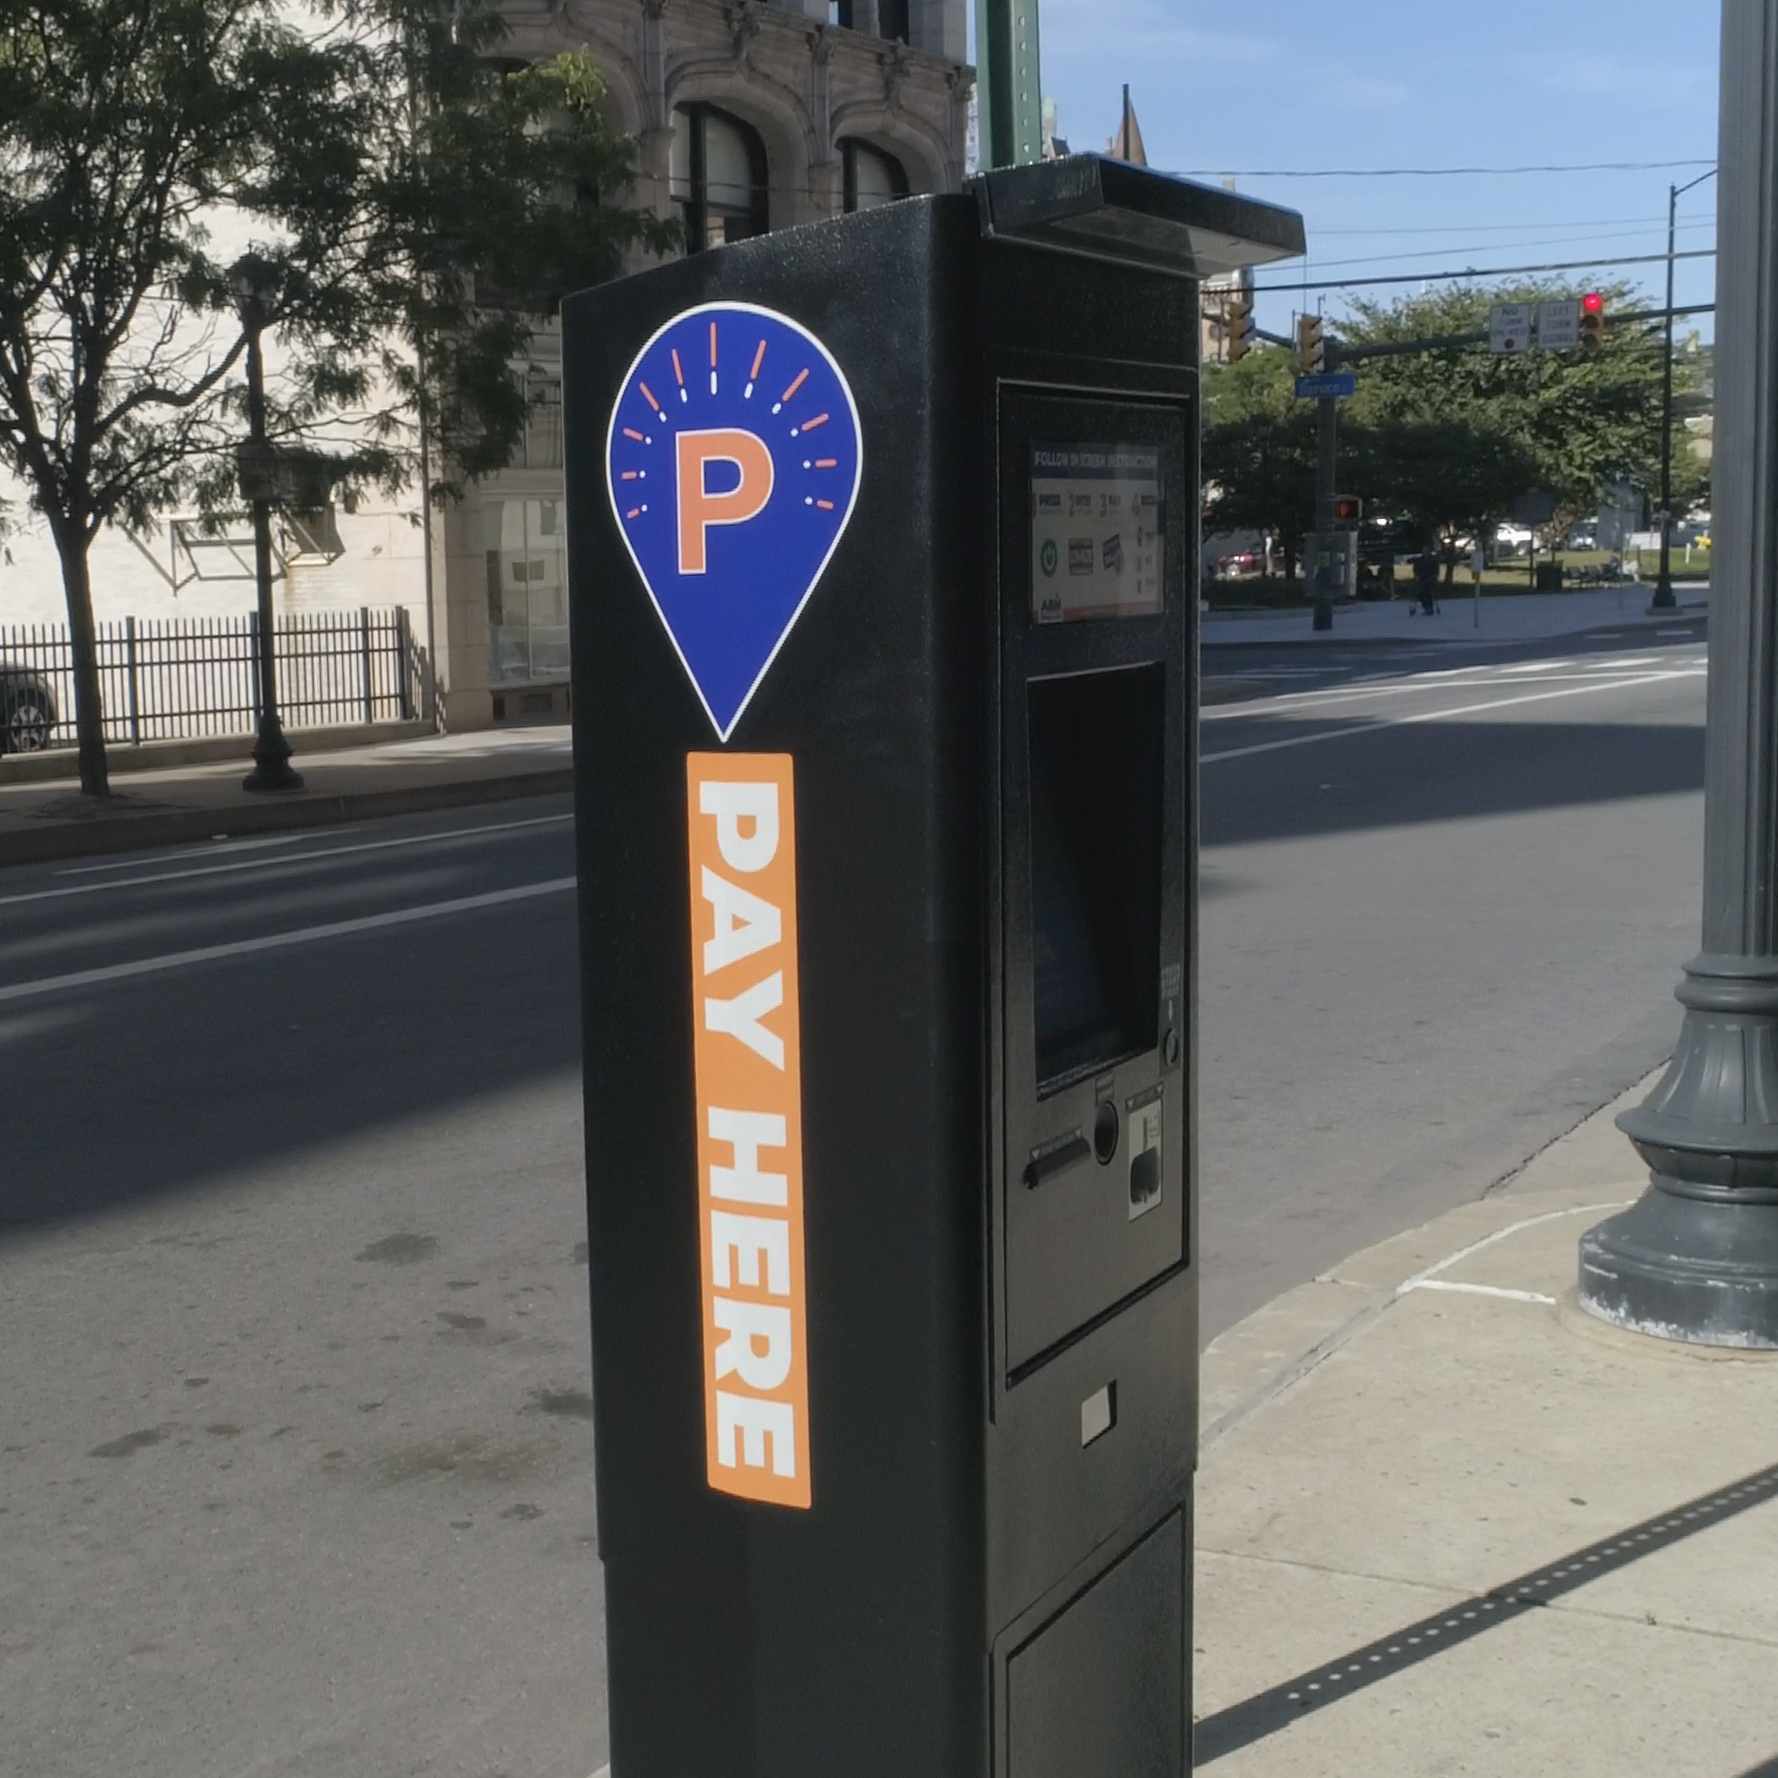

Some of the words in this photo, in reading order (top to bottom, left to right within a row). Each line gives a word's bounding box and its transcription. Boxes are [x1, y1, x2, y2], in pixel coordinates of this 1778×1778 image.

[1502, 307, 1519, 316] NO
[1509, 327, 1527, 335] RED
[1547, 319, 1571, 329] TURN
[1034, 451, 1068, 467] FOLLOW
[675, 427, 775, 575] P
[699, 780, 785, 1072] PAY
[707, 1105, 796, 1479] HERE
